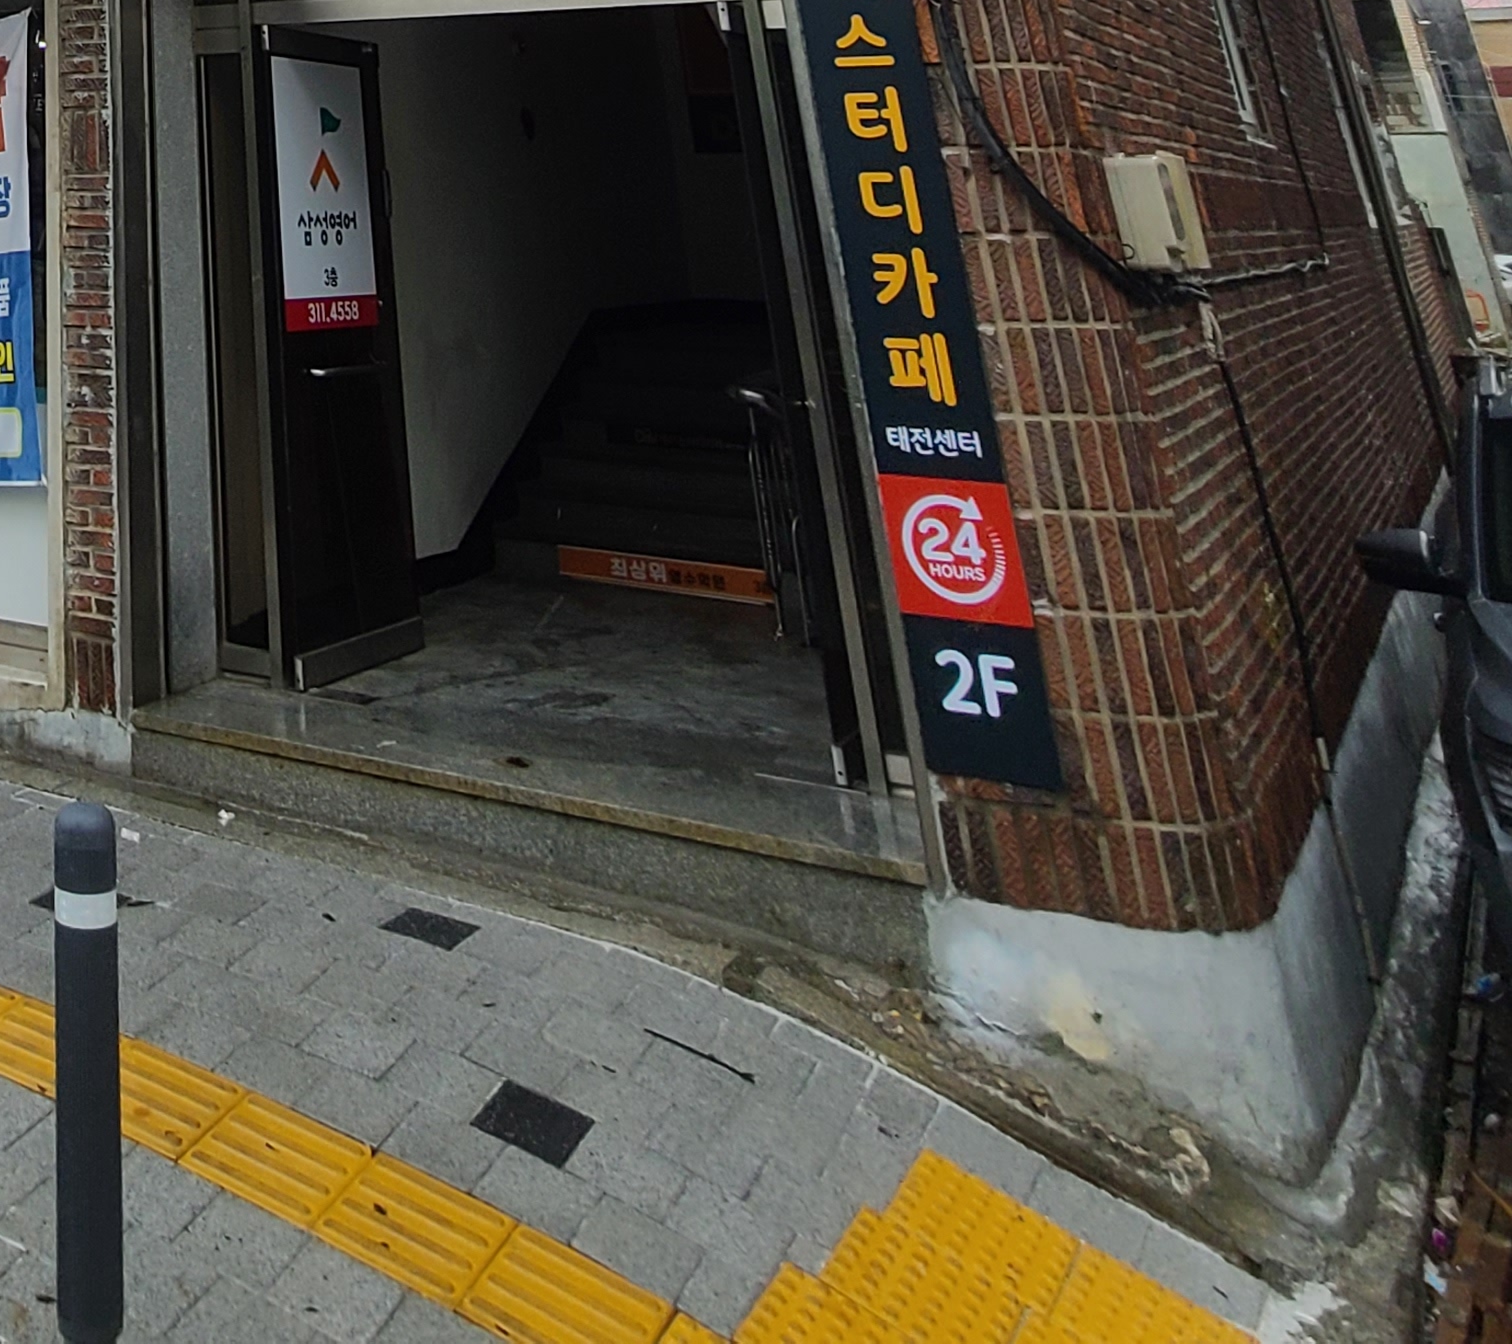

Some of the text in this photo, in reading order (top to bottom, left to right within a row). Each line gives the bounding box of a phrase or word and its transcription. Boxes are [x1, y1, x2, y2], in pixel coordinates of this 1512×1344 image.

[298, 211, 358, 247] 삼성영어
[324, 267, 339, 288] 3층
[308, 300, 360, 325] 311.4558
[885, 425, 983, 459] 태전센터
[918, 517, 987, 565] 24
[609, 556, 668, 583] 최상위
[929, 562, 987, 583] HOURS
[935, 648, 1019, 719] 2F
